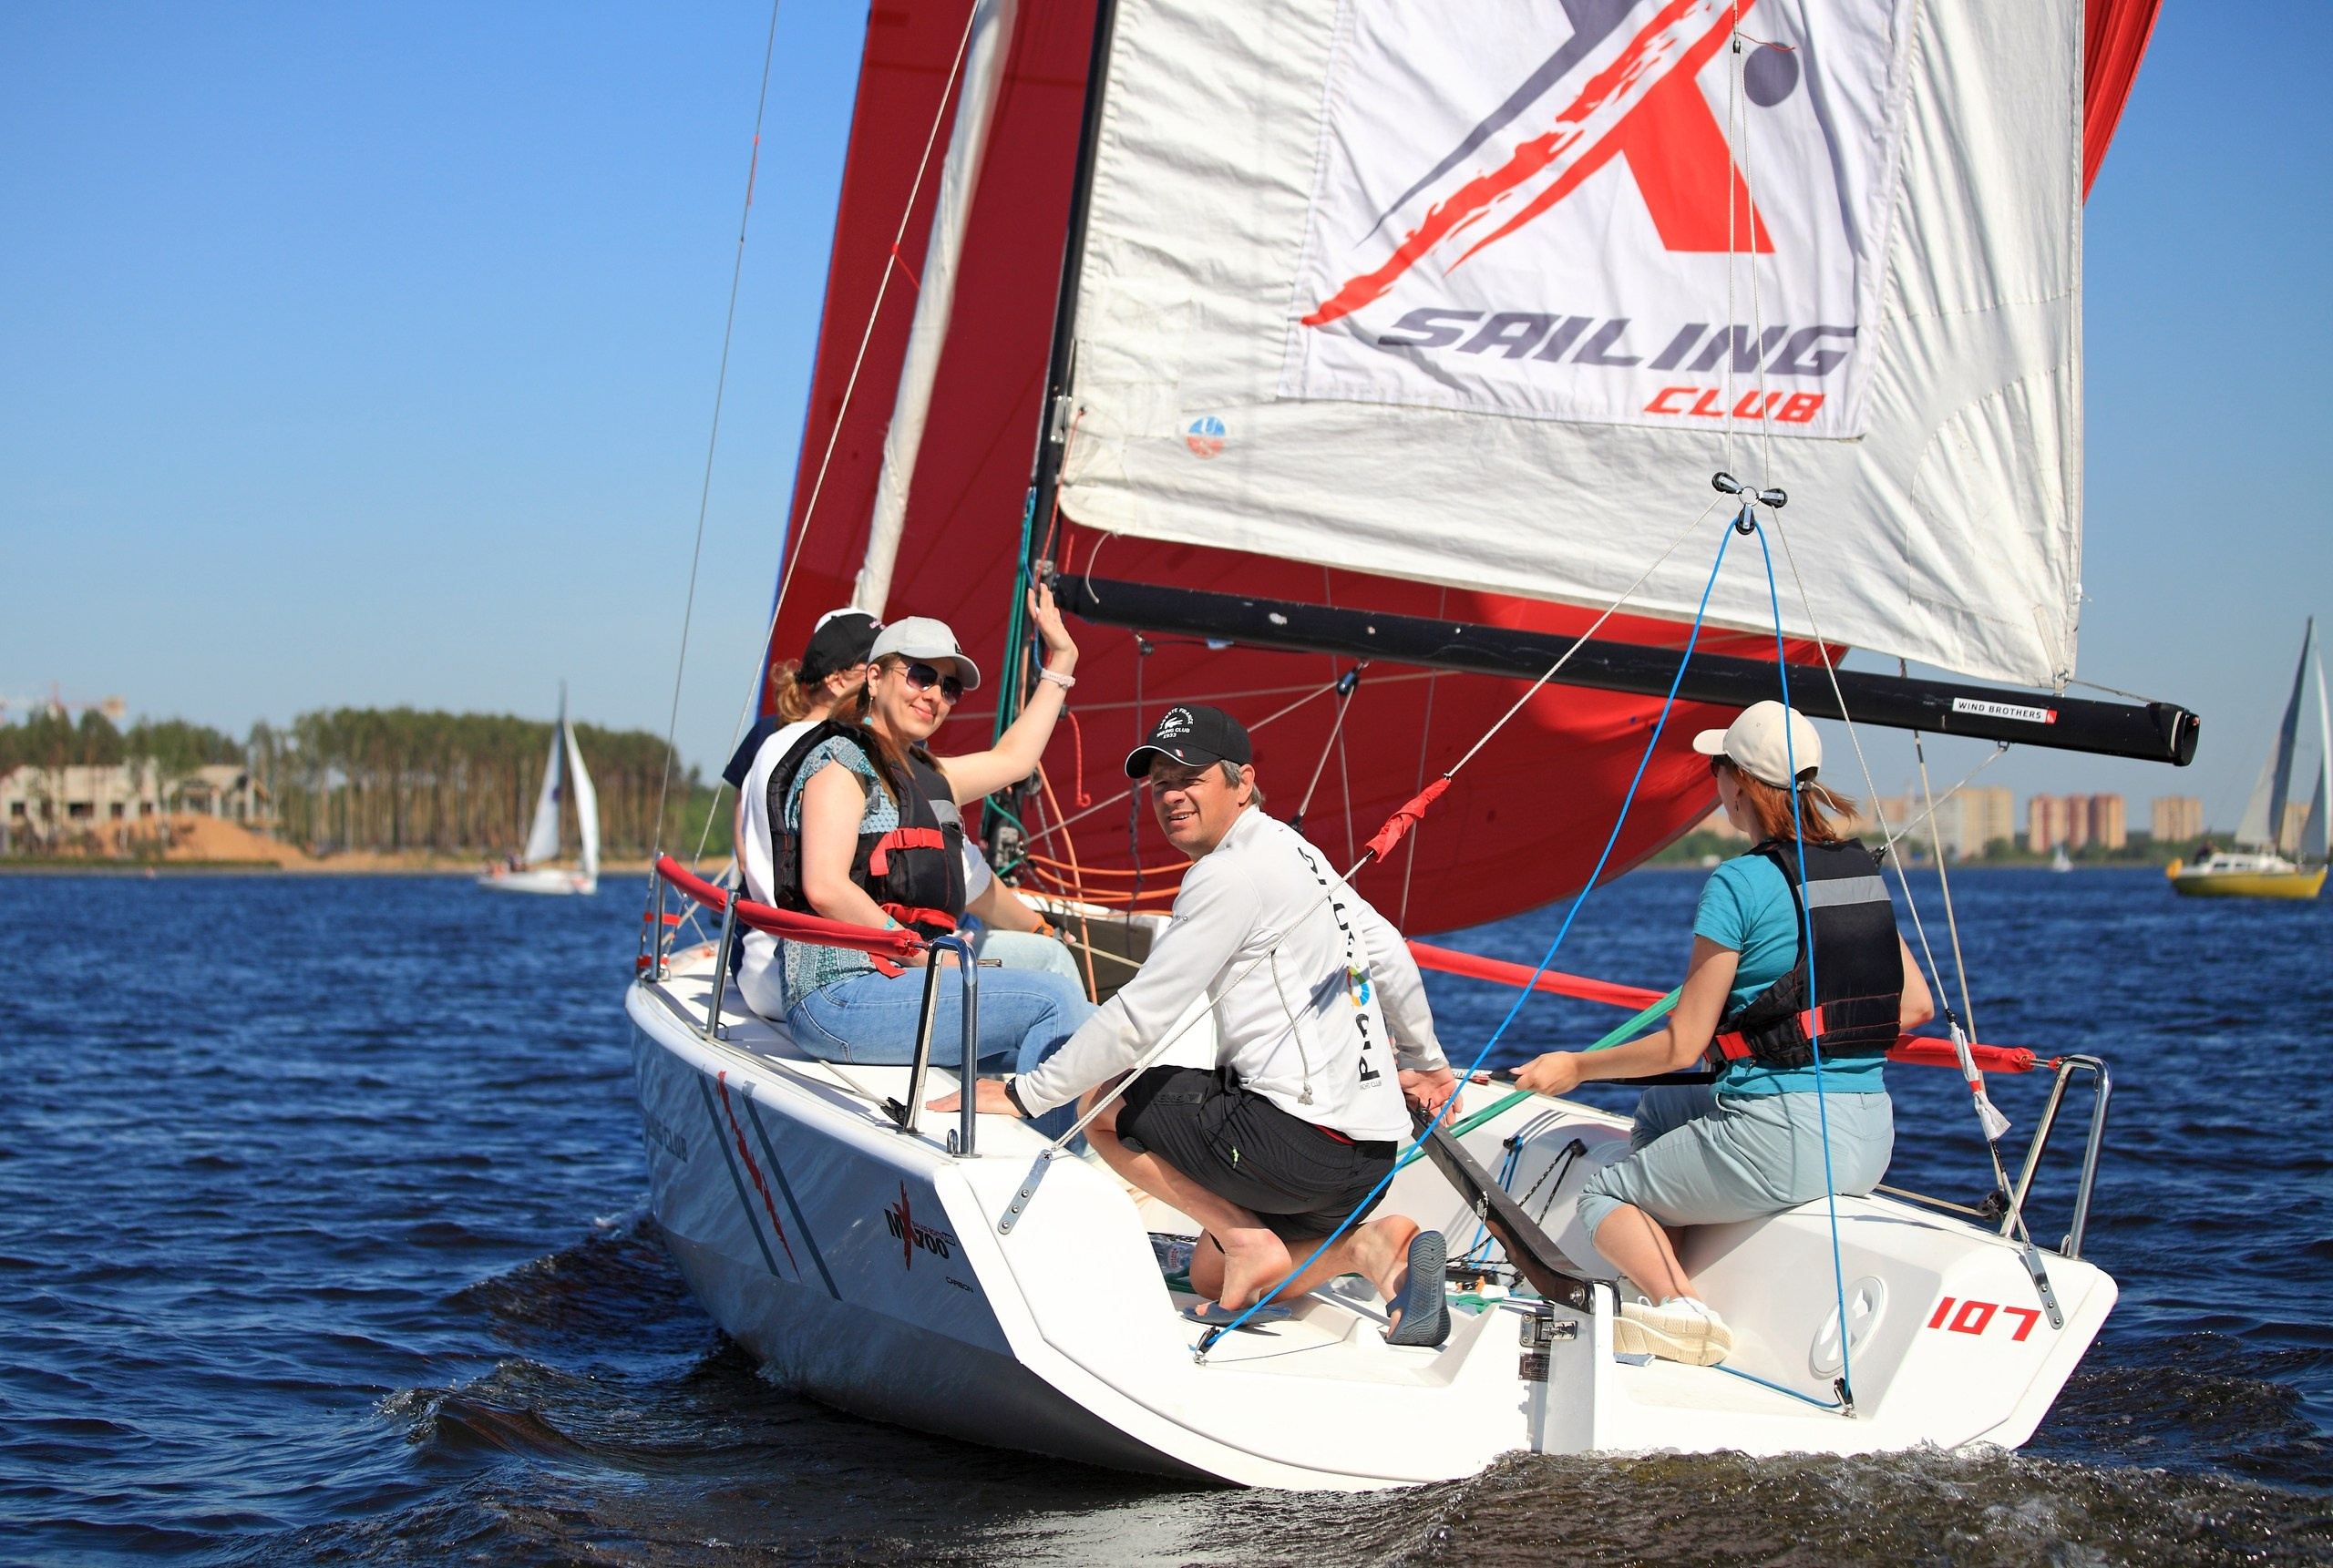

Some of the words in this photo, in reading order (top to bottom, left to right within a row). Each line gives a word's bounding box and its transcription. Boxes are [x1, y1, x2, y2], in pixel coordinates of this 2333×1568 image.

[1378, 307, 1858, 376] SAILING
[1643, 386, 1825, 423] CLUB
[1958, 701, 1985, 712] WIND
[1989, 705, 2041, 720] BROTHERS
[1927, 1296, 2042, 1342] 107
